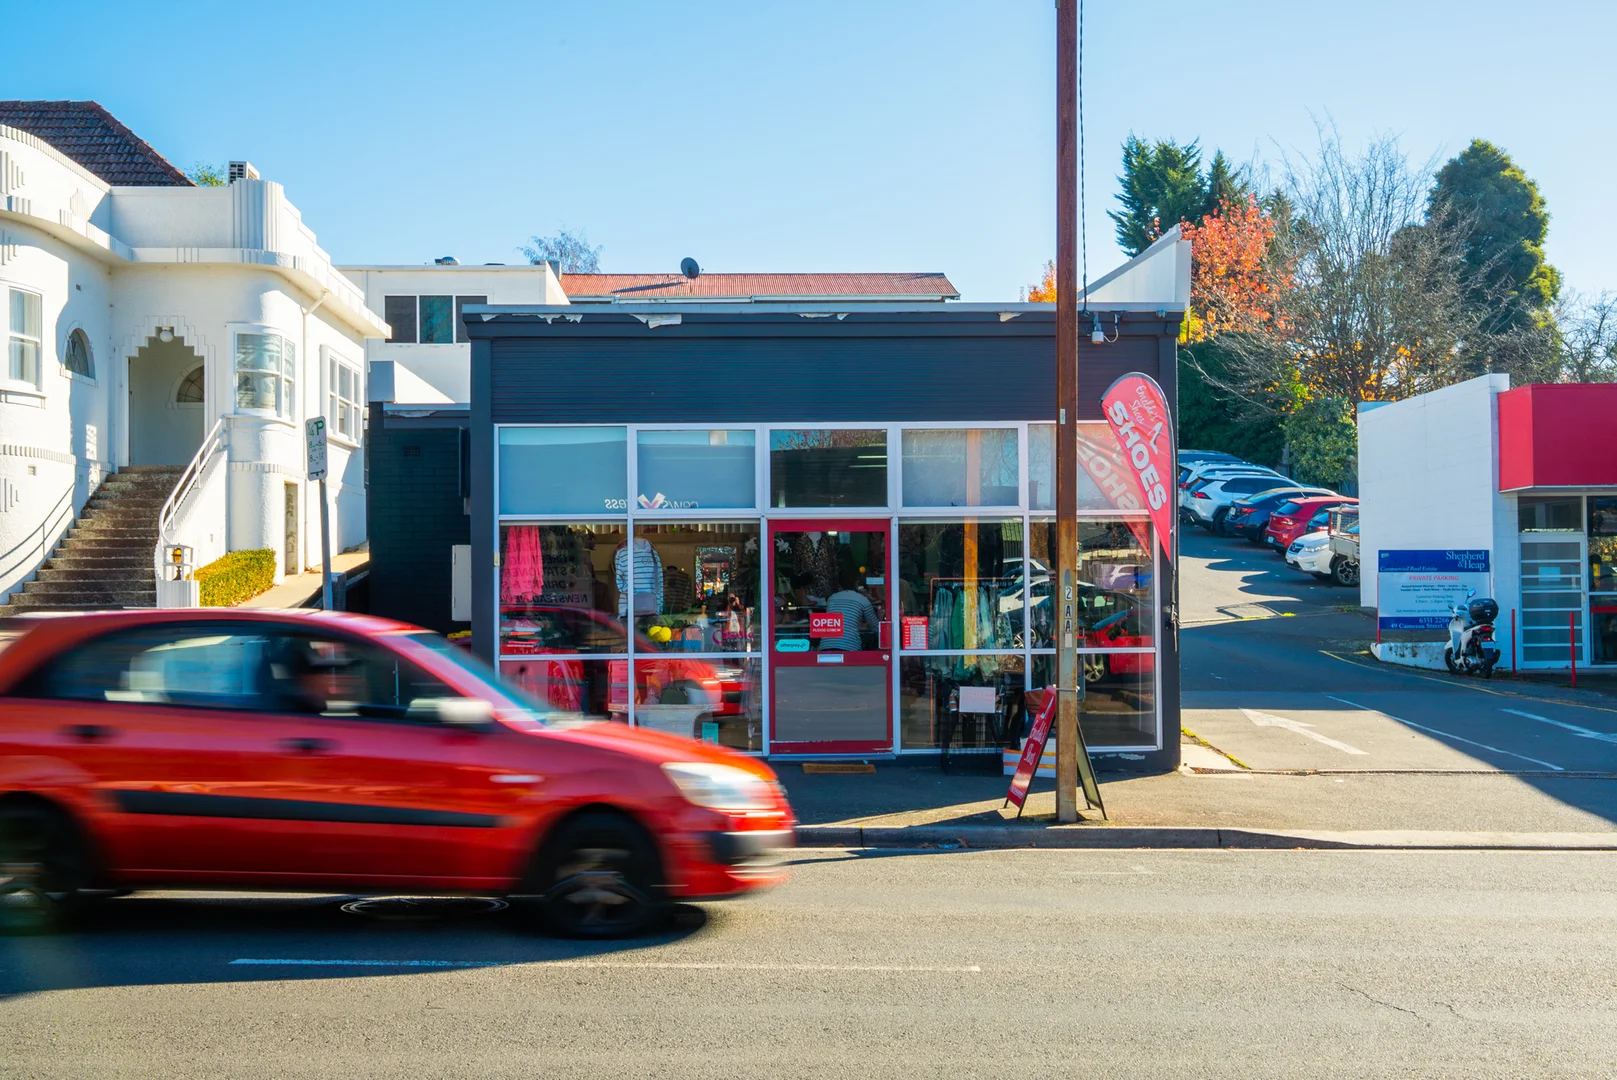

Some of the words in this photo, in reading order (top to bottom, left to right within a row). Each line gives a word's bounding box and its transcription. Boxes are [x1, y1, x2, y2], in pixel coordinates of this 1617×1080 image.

[1108, 400, 1167, 511] SHOES
[1446, 550, 1484, 562] Shepherd
[1464, 560, 1485, 571] Heap
[812, 618, 840, 627] OPEN
